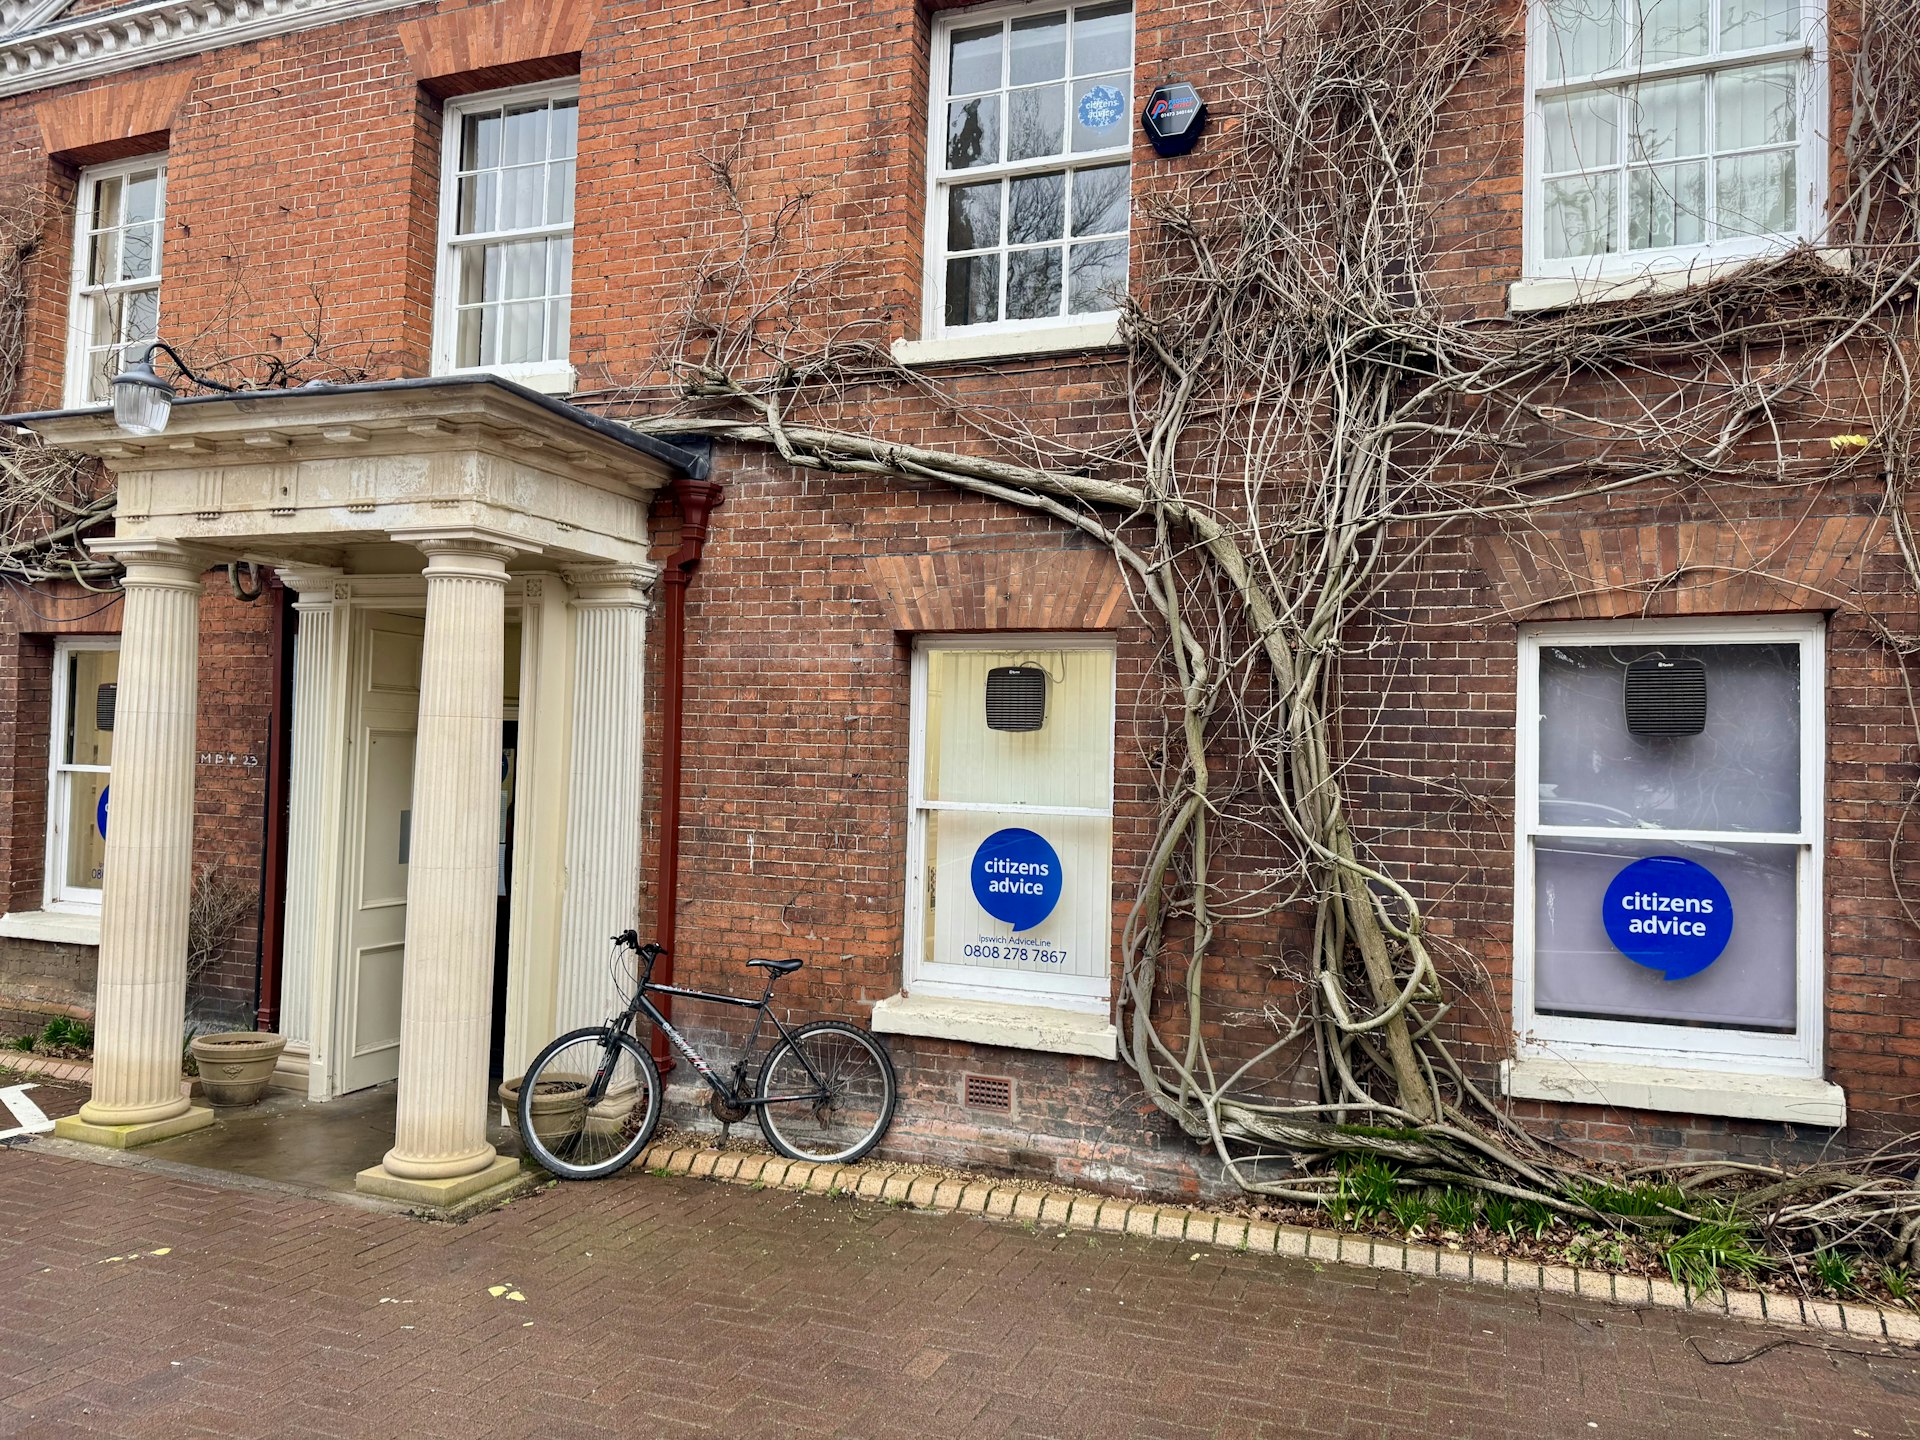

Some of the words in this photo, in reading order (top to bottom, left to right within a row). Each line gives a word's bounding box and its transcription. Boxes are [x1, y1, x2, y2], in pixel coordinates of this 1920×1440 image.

[984, 857, 1049, 876] citizens
[988, 877, 1044, 895] advice
[1621, 891, 1714, 914] citizens
[1628, 915, 1707, 937] advice
[978, 934, 1007, 946] Ipswich
[1008, 935, 1052, 947] AdviceLine
[963, 944, 1000, 959] 0808
[1003, 946, 1029, 961] 278
[1032, 949, 1067, 964] 7867
